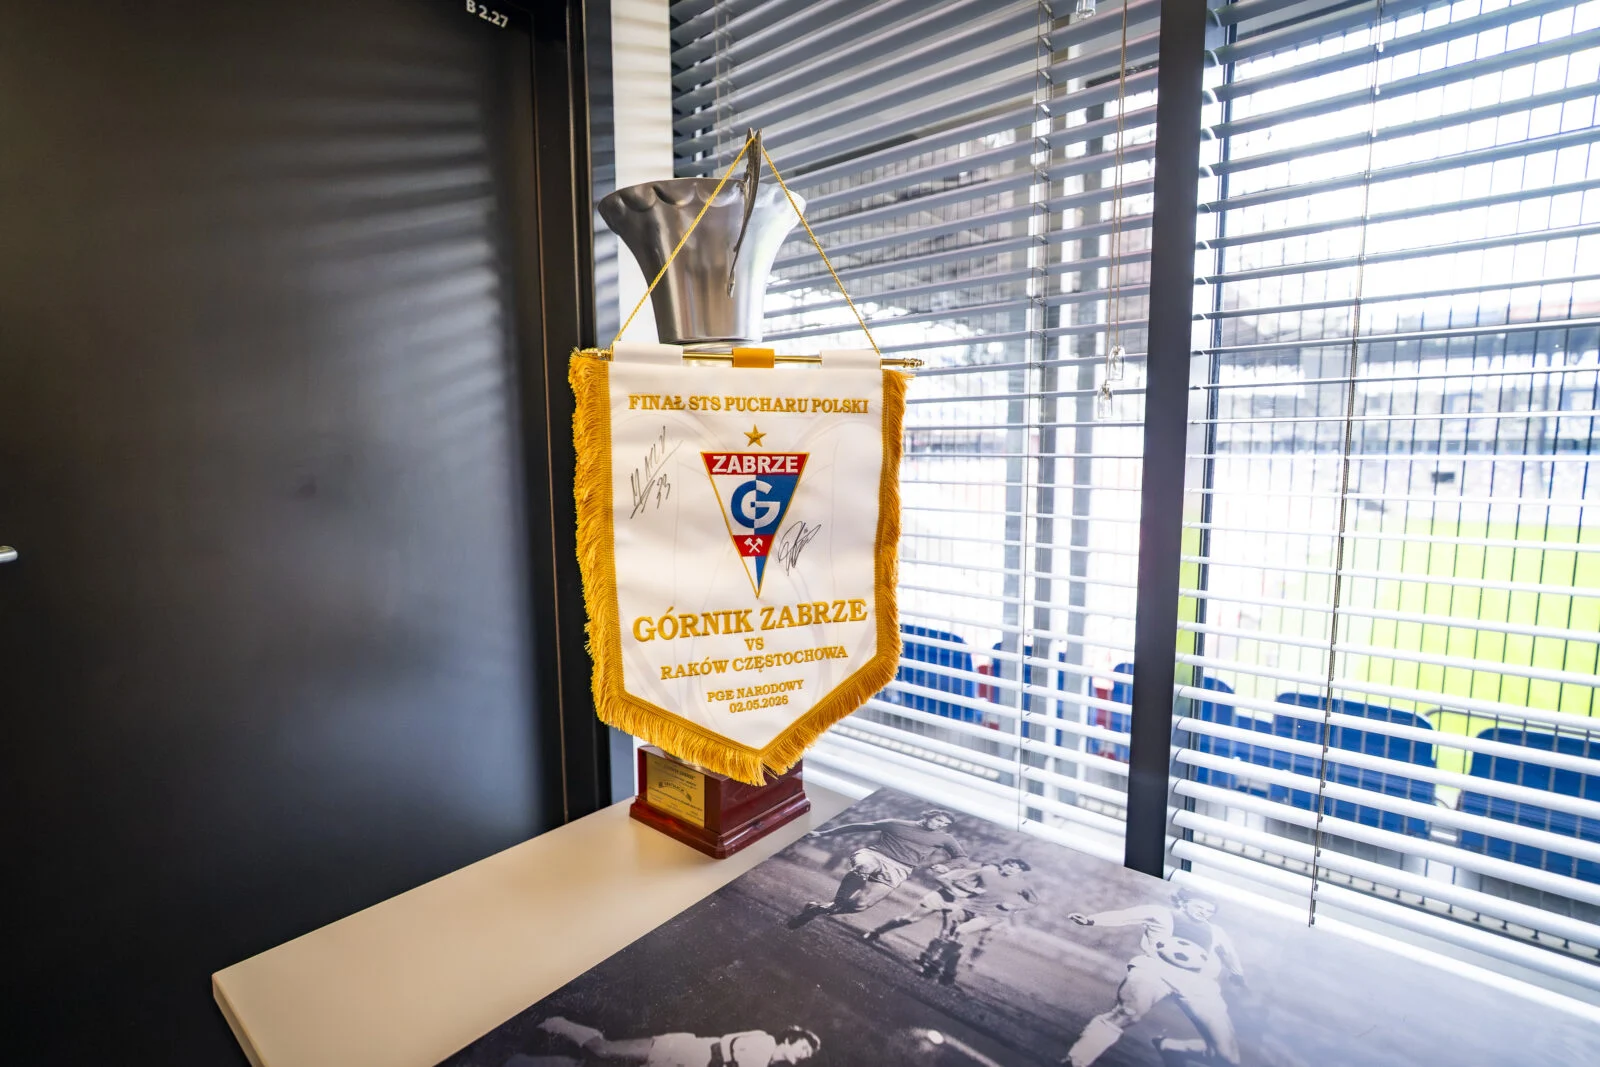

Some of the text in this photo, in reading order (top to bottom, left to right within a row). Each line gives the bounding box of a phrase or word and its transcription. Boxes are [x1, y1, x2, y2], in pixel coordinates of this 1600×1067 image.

[466, 0, 509, 28] B 2.27
[628, 394, 869, 414] FINAŁ STS PUCHARU POLSKI
[712, 455, 799, 474] ZABRZE
[632, 598, 868, 643] GÓRNIK ZABRZE
[744, 636, 765, 652] VS
[660, 645, 848, 680] RAKÓW CZĘSTOCHOWA
[707, 679, 805, 703] PGE NARODOWY
[729, 695, 789, 714] 02.05.2026
